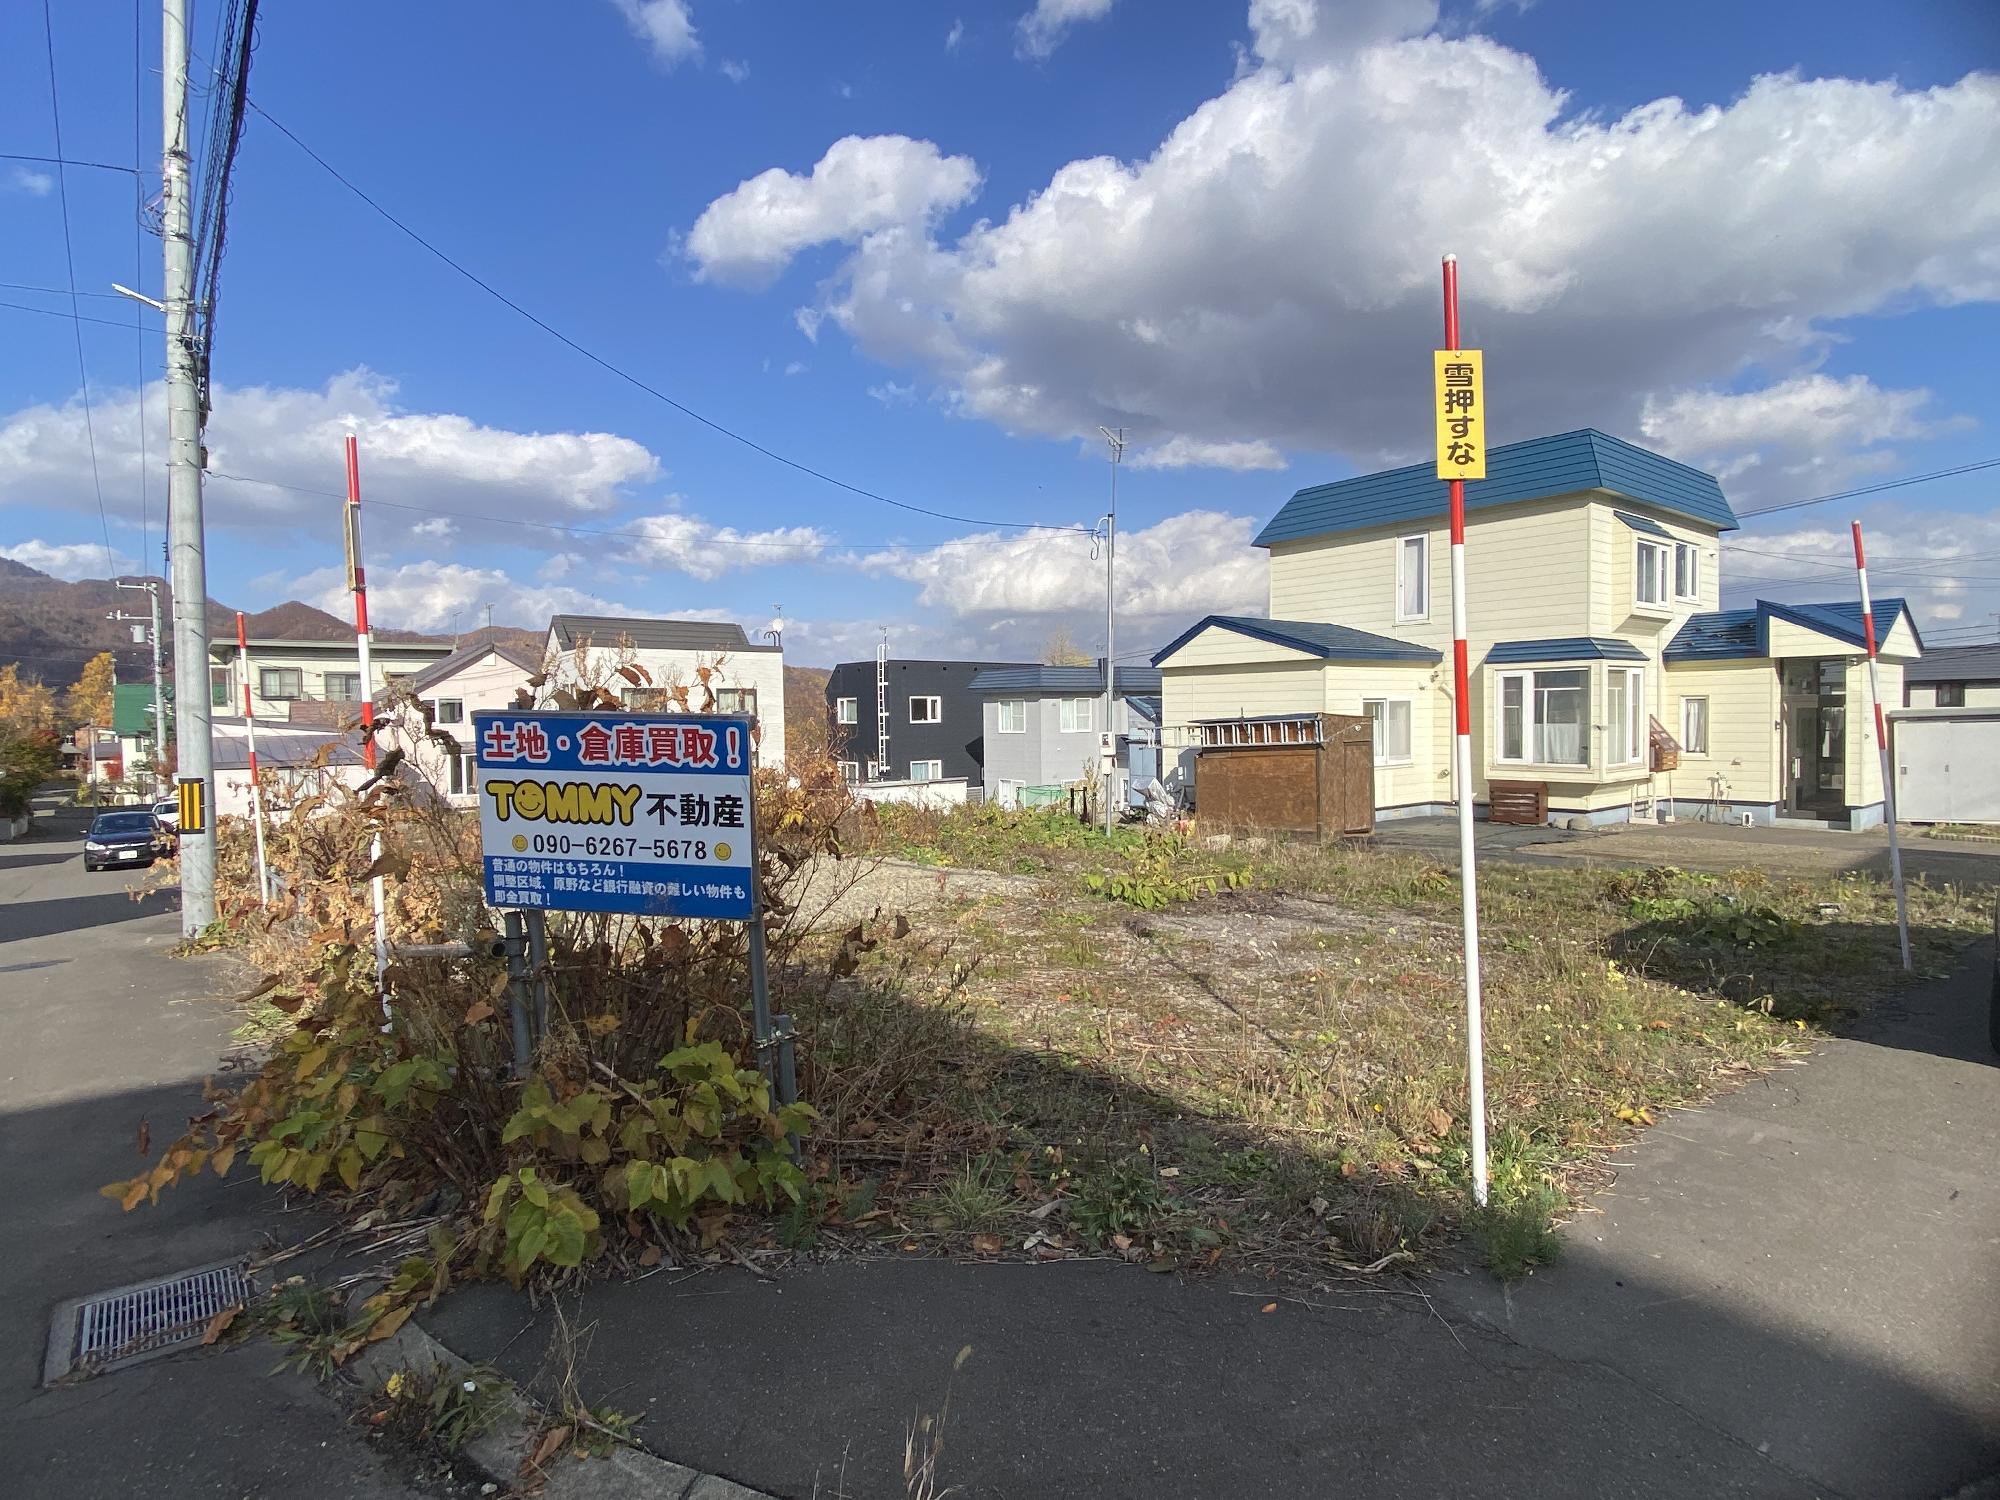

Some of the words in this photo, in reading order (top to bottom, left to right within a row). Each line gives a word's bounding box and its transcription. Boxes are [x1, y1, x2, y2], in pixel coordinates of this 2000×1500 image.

[1444, 363, 1475, 465] 雪押すな
[484, 722, 741, 768] 土地・倉庫買取!
[486, 779, 642, 825] TOMMY
[646, 793, 745, 828] 不動産
[533, 834, 707, 860] 090-6267-5678
